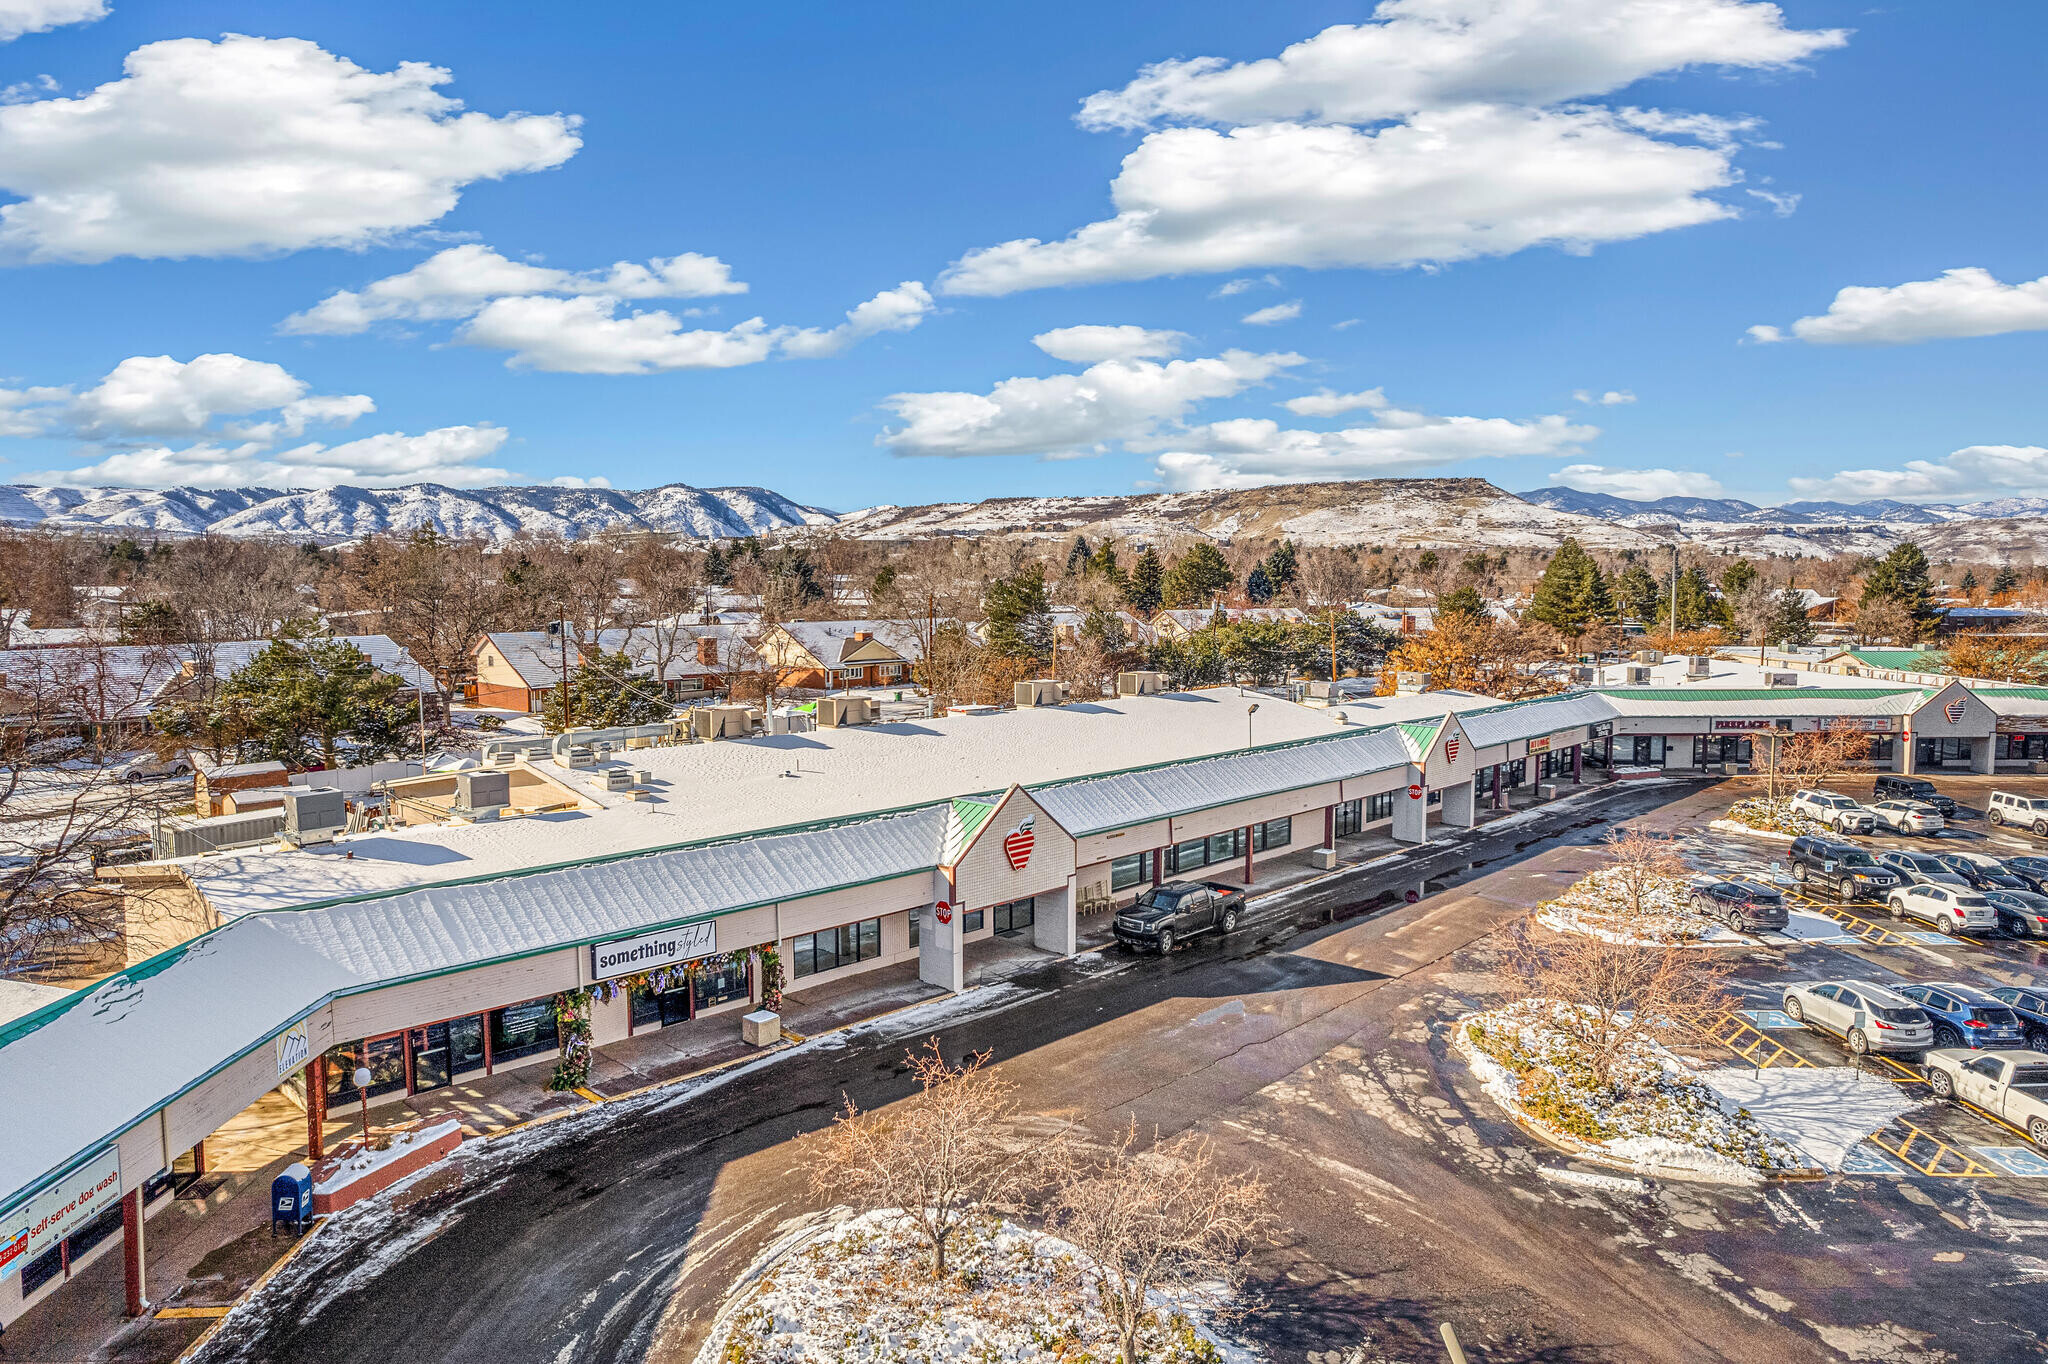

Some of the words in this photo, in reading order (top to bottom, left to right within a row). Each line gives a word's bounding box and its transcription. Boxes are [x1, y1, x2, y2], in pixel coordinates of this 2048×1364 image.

[1409, 788, 1422, 796] STOP
[936, 906, 951, 919] STOP
[600, 940, 676, 969] something
[676, 922, 713, 959] styled
[279, 1047, 308, 1074] ELEVATION
[30, 1200, 76, 1239] self-serve
[78, 1186, 94, 1205] dog
[96, 1170, 118, 1192] wash
